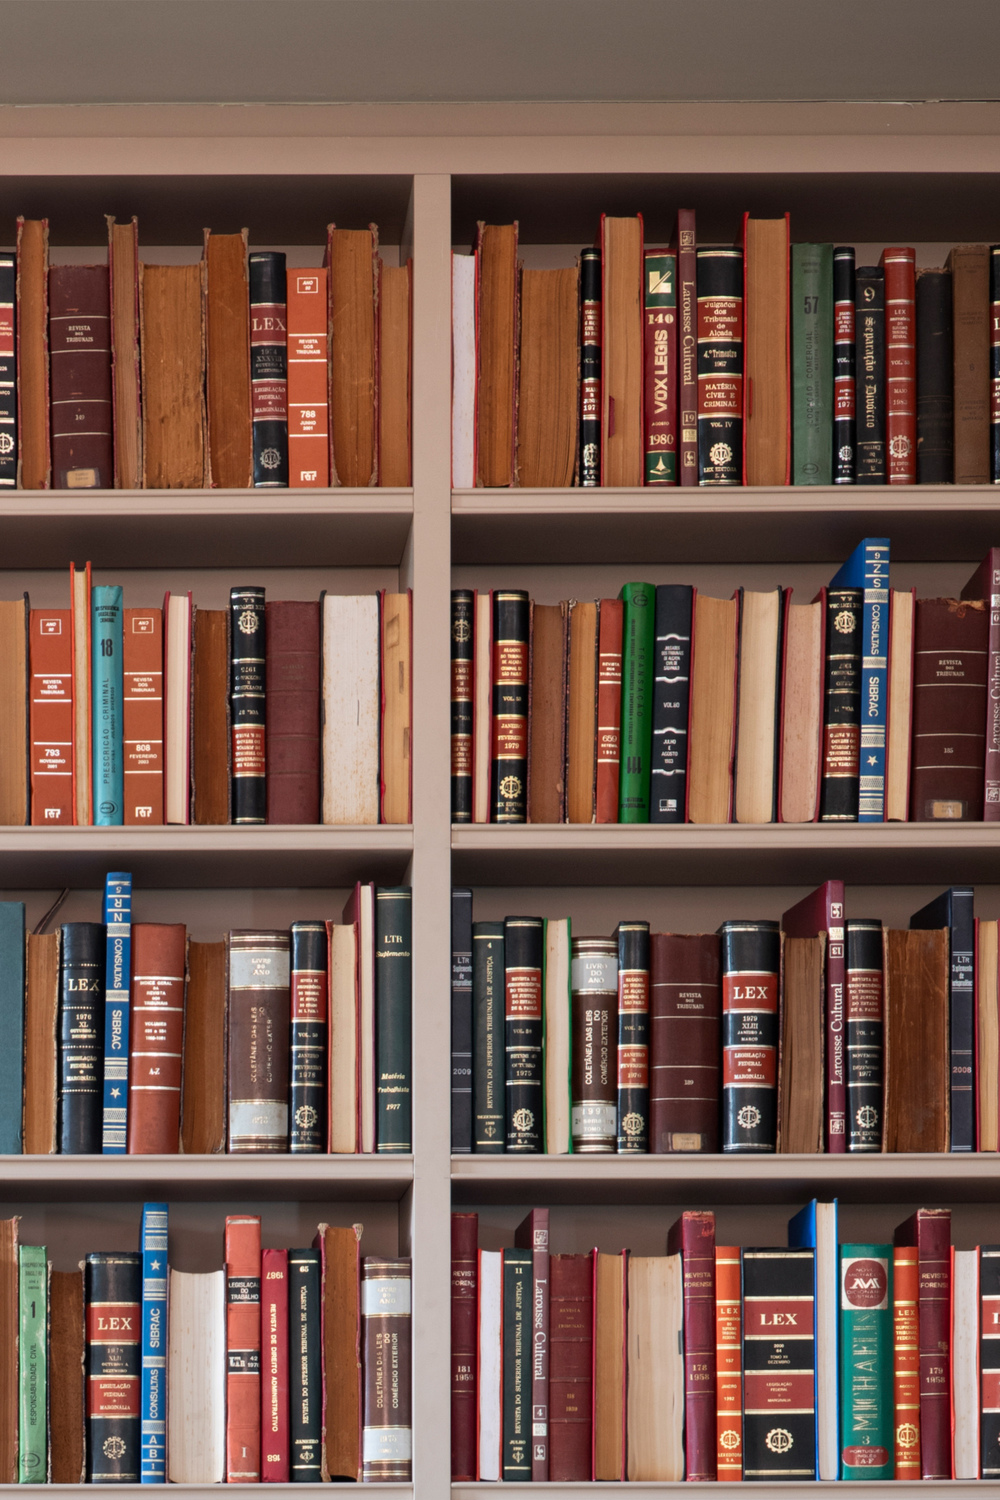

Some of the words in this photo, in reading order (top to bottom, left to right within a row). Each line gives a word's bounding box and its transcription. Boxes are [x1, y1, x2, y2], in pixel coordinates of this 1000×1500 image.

[683, 281, 695, 333] Larousse
[704, 301, 737, 310] Julgados
[804, 296, 819, 315] 57
[252, 318, 287, 332] LEX
[648, 313, 674, 325] 140
[708, 329, 733, 338] Alçada
[654, 329, 669, 375] LEGIS
[683, 335, 695, 386] Cultural
[705, 382, 738, 391] MATÉRIA
[654, 377, 669, 414] VOX
[703, 400, 738, 408] CRIMINAL
[300, 410, 316, 418] 788
[649, 434, 674, 446] 1980
[870, 604, 881, 655] CONSULTAS
[101, 639, 113, 657] 18
[868, 676, 880, 718] SIBRAC
[45, 749, 60, 757] 793
[136, 744, 151, 752] 808
[113, 938, 122, 989] CONSULTAS
[68, 979, 100, 992] LEX
[487, 985, 493, 996] DE
[733, 986, 769, 1000] LEX
[830, 982, 843, 1033] Cultural
[585, 1010, 593, 1026] LEIS
[593, 1010, 601, 1022] DO
[112, 1009, 122, 1050] SIBRAC
[585, 1027, 593, 1042] DAS
[584, 1043, 593, 1085] COLETÂNEA
[831, 1034, 843, 1086] Larousse
[453, 1068, 472, 1076] 2009
[487, 1068, 493, 1079] DO
[953, 1066, 972, 1074] 2008
[266, 1272, 284, 1280] 1987
[299, 1265, 310, 1273] 65
[515, 1281, 523, 1309] JUSTIÇA
[535, 1278, 547, 1329] Larousse
[515, 1310, 522, 1321] DE
[760, 1313, 798, 1326] LEX
[97, 1317, 133, 1331] LEX
[150, 1307, 161, 1348] SIBRAC
[270, 1334, 277, 1344] DE
[384, 1333, 391, 1344] DO
[391, 1332, 399, 1369] EXTERIOR
[535, 1331, 547, 1381] Cultural
[270, 1346, 278, 1374] DIREITO
[150, 1369, 160, 1419] CONSULTAS
[390, 1369, 399, 1409] COMÉRCIO
[271, 1376, 279, 1432] ADMINISTRATIVO
[515, 1394, 522, 1405] DO
[536, 1408, 543, 1417] 4
[514, 1406, 522, 1434] REVISTA
[149, 1449, 158, 1458] B
